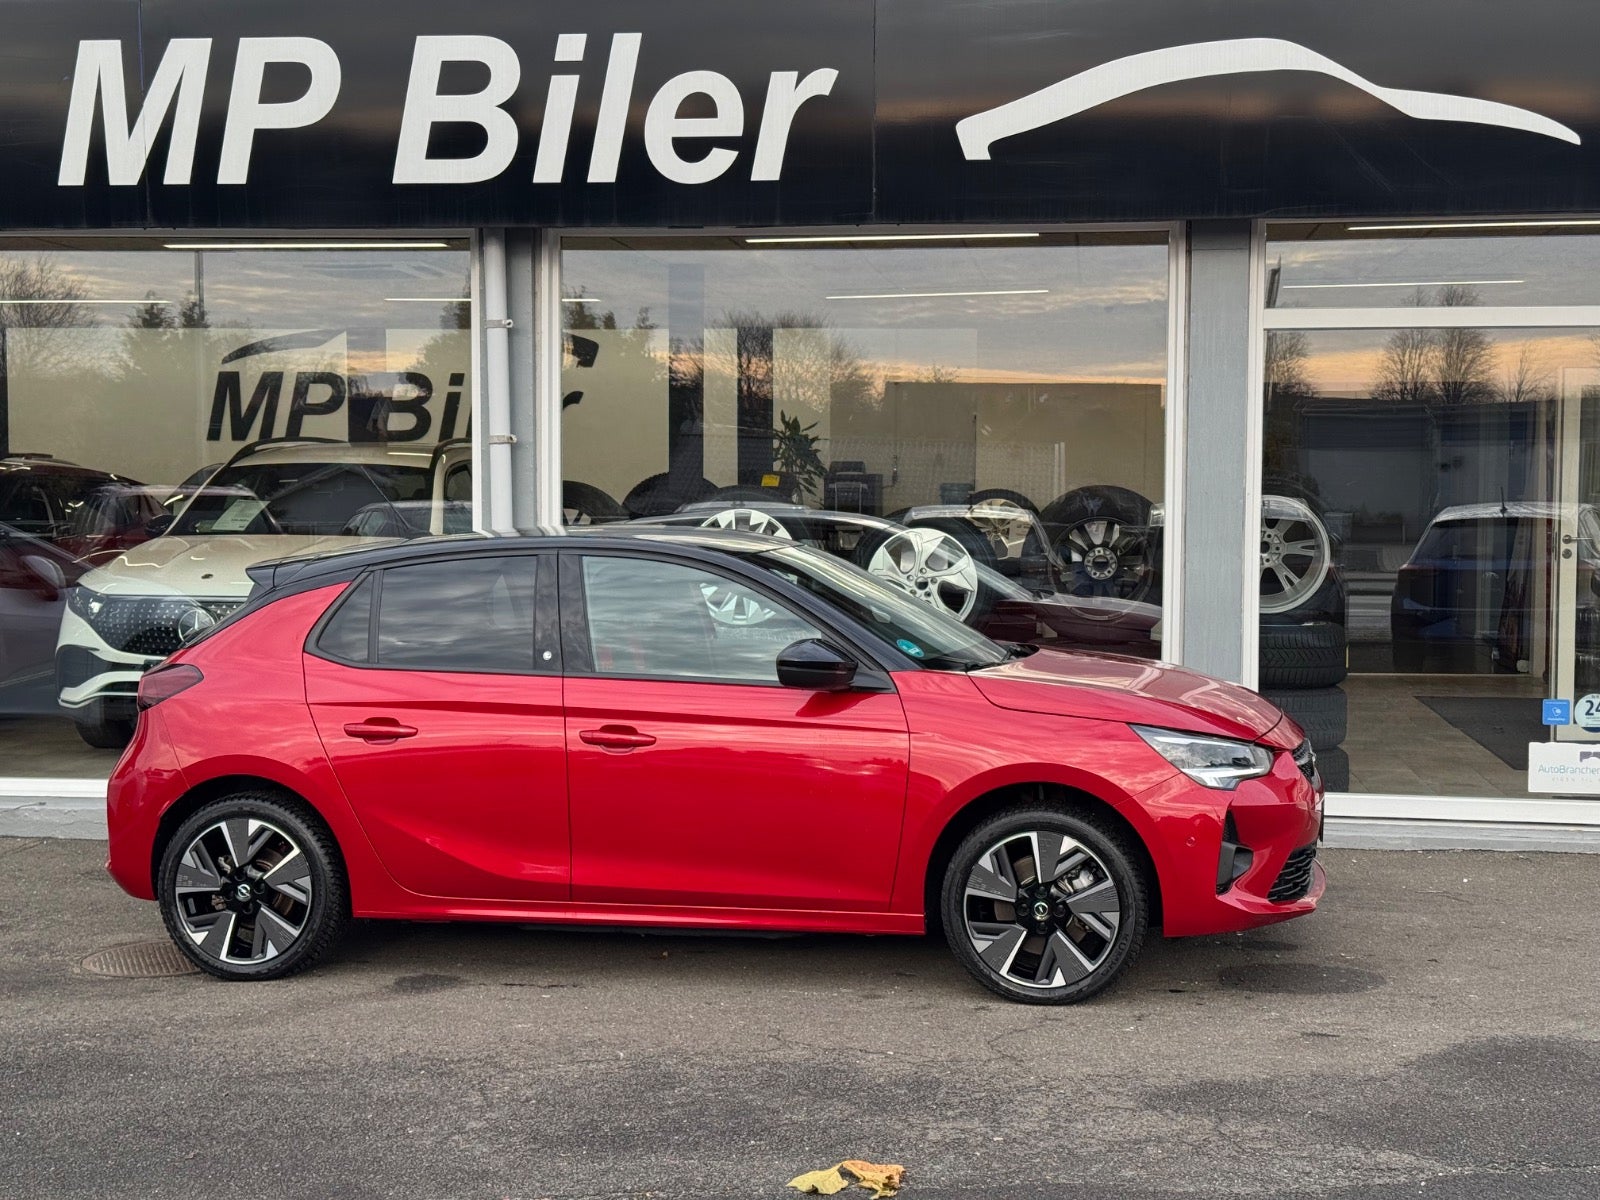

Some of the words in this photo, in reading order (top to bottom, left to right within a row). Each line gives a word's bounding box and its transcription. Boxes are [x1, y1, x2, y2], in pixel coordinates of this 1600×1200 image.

[58, 37, 341, 185] MP
[393, 33, 839, 184] Biler
[206, 370, 349, 442] MP
